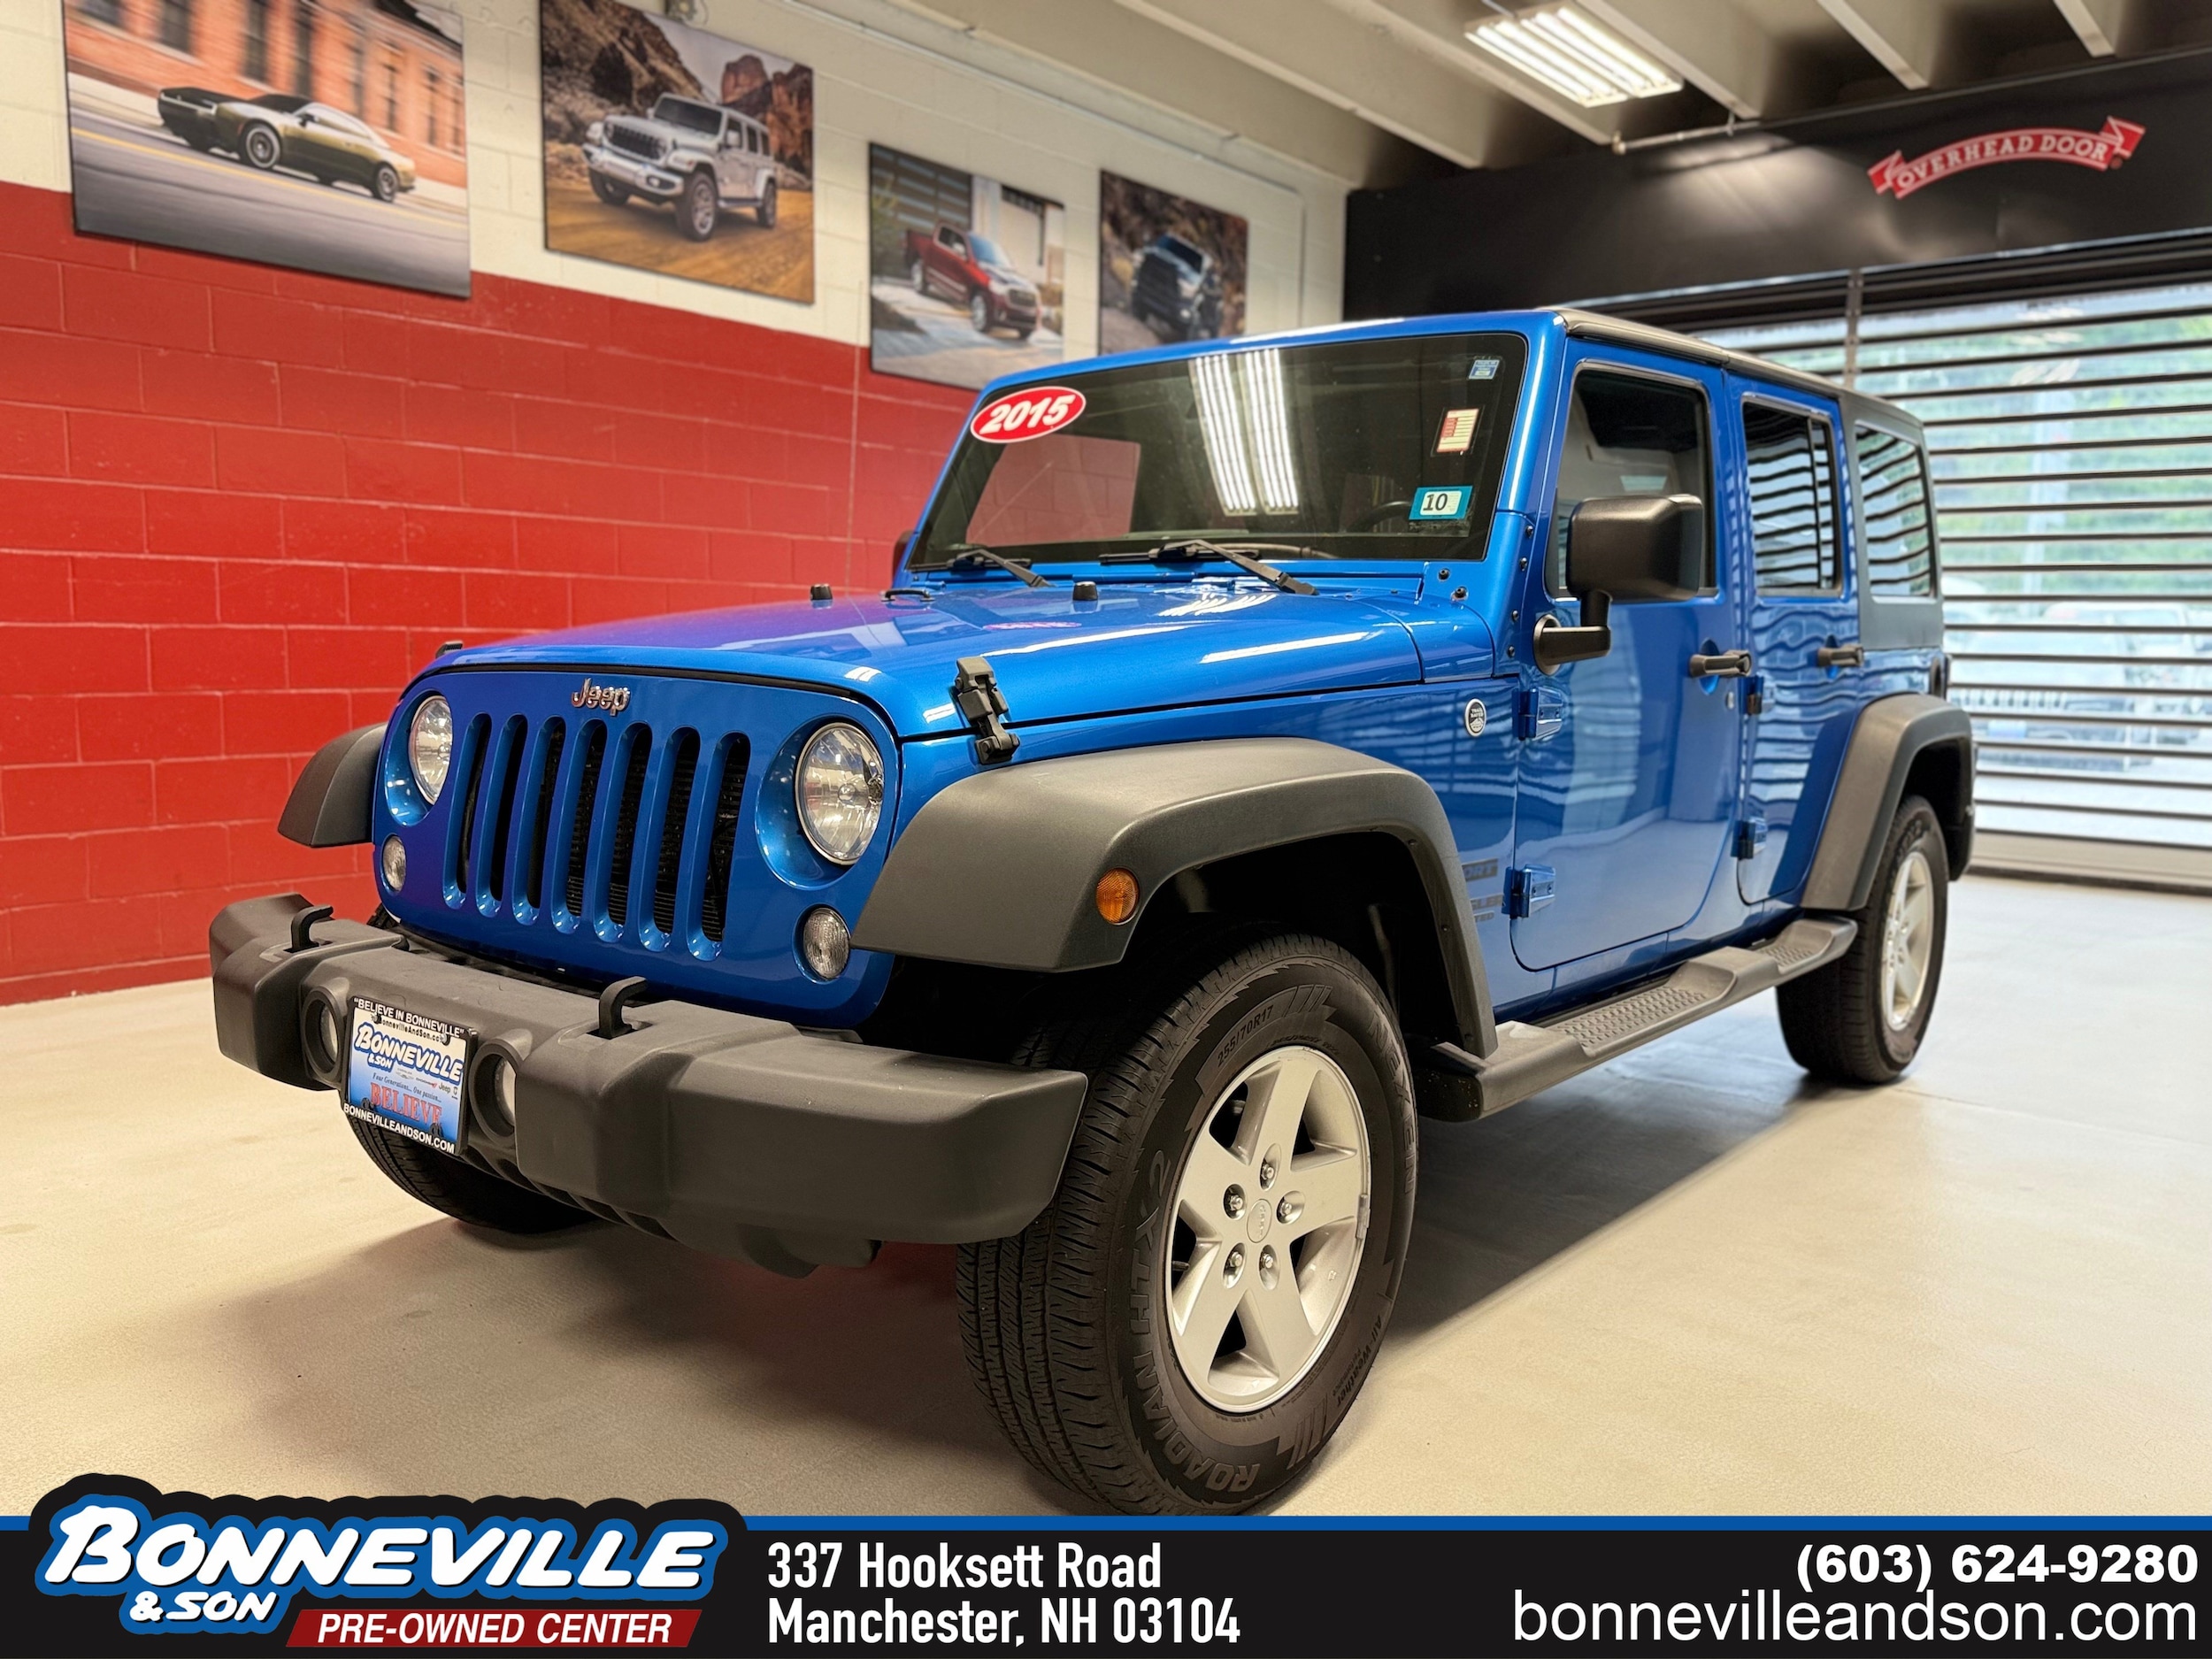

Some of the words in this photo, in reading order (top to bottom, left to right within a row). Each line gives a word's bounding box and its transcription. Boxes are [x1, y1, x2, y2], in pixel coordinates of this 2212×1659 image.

[1896, 135, 2033, 190] OVERHEAD
[2039, 134, 2108, 161] DOOR
[979, 394, 1076, 435] 2015
[1423, 493, 1448, 511] 10
[571, 678, 631, 716] Jeep
[396, 1010, 404, 1021] IN
[1217, 1005, 1273, 1067] 255/70R17
[355, 1023, 463, 1083] BONNEVILLE
[371, 1082, 442, 1126] BELIEVE
[343, 1103, 455, 1154] BONNEVILLEANDSON.COM
[1133, 1351, 1261, 1493] ROADIAN
